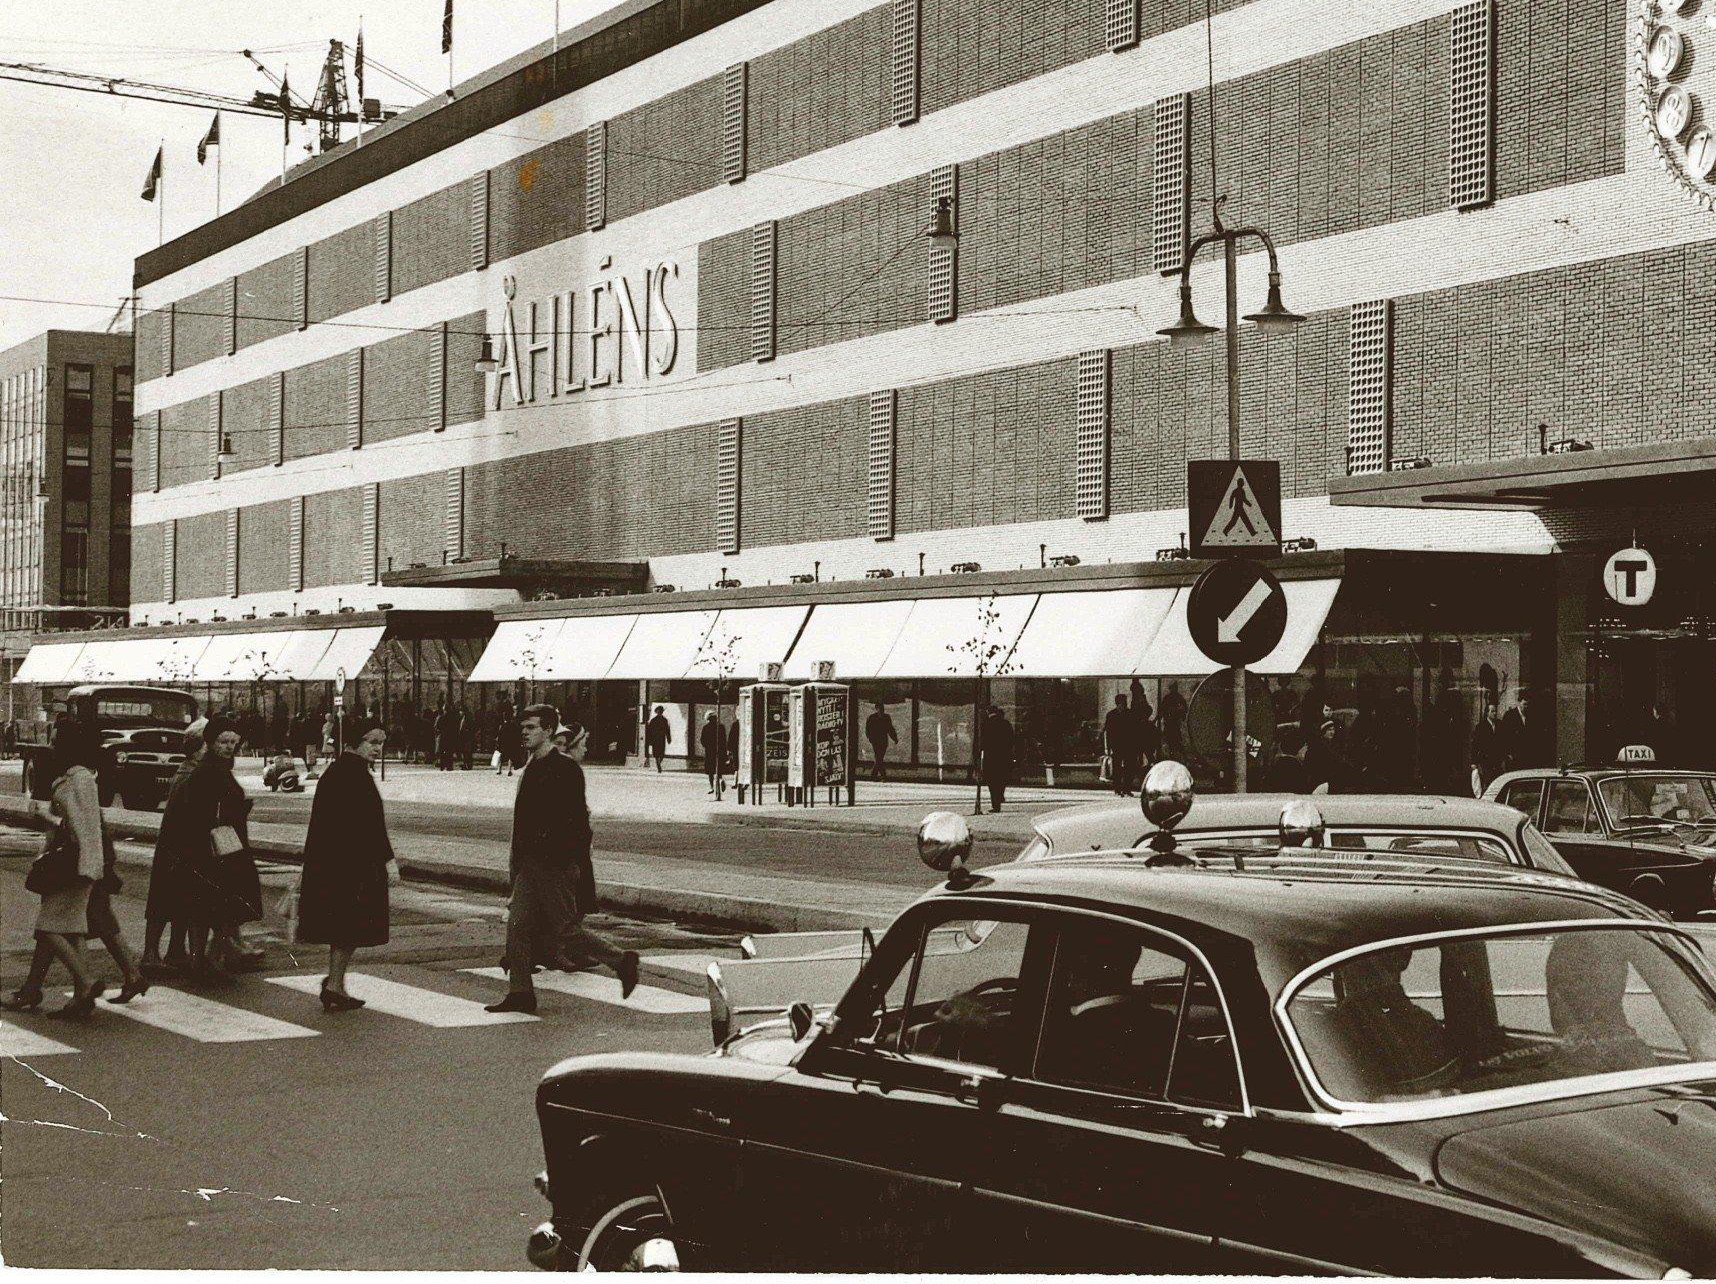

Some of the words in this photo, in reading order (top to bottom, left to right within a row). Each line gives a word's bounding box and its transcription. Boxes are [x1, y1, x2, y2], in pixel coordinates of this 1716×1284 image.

[1656, 32, 1674, 70] 9
[1665, 92, 1681, 128] 8
[1693, 131, 1711, 169] 7
[491, 254, 680, 411] ÅHLÉNS
[1613, 560, 1648, 598] T
[766, 748, 788, 757] ZEIS
[1627, 749, 1651, 759] TAXI
